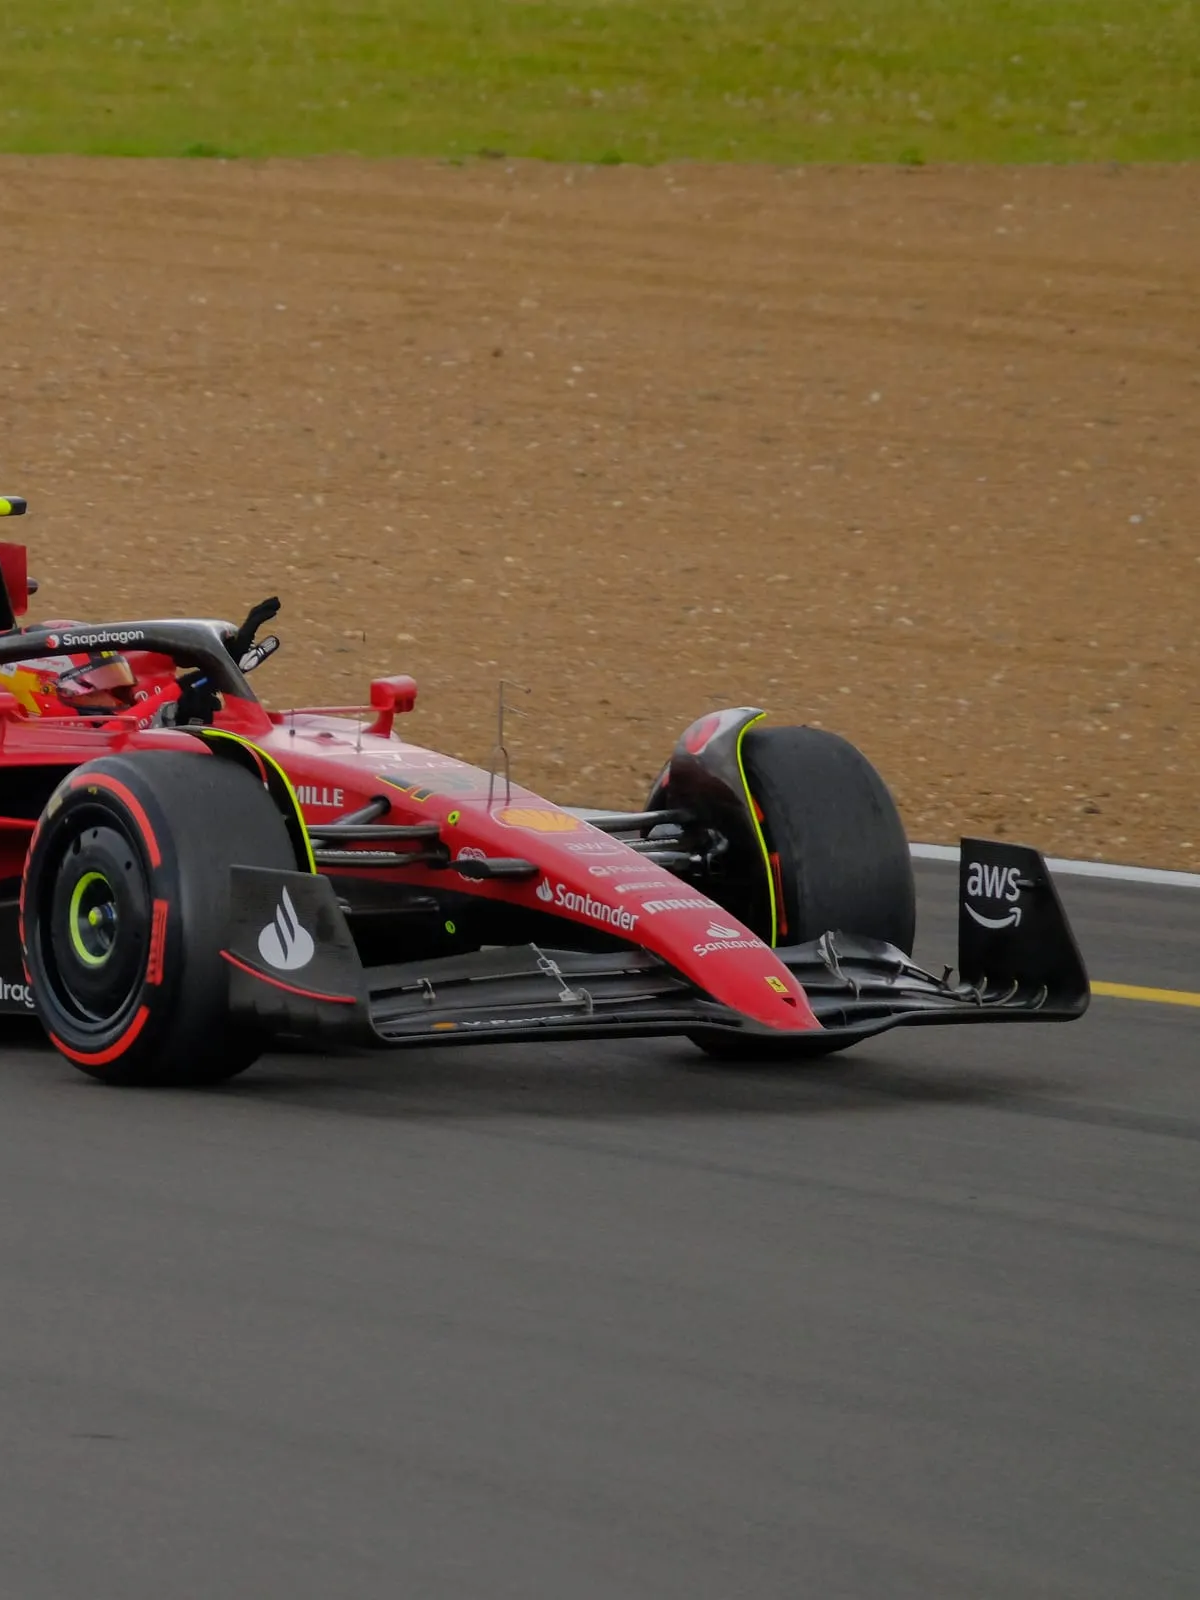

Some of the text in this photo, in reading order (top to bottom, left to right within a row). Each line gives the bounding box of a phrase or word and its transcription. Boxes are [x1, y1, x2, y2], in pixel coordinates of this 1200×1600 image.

[62, 629, 145, 647] Snapdragon
[966, 861, 1022, 902] aws
[554, 883, 640, 932] Santander
